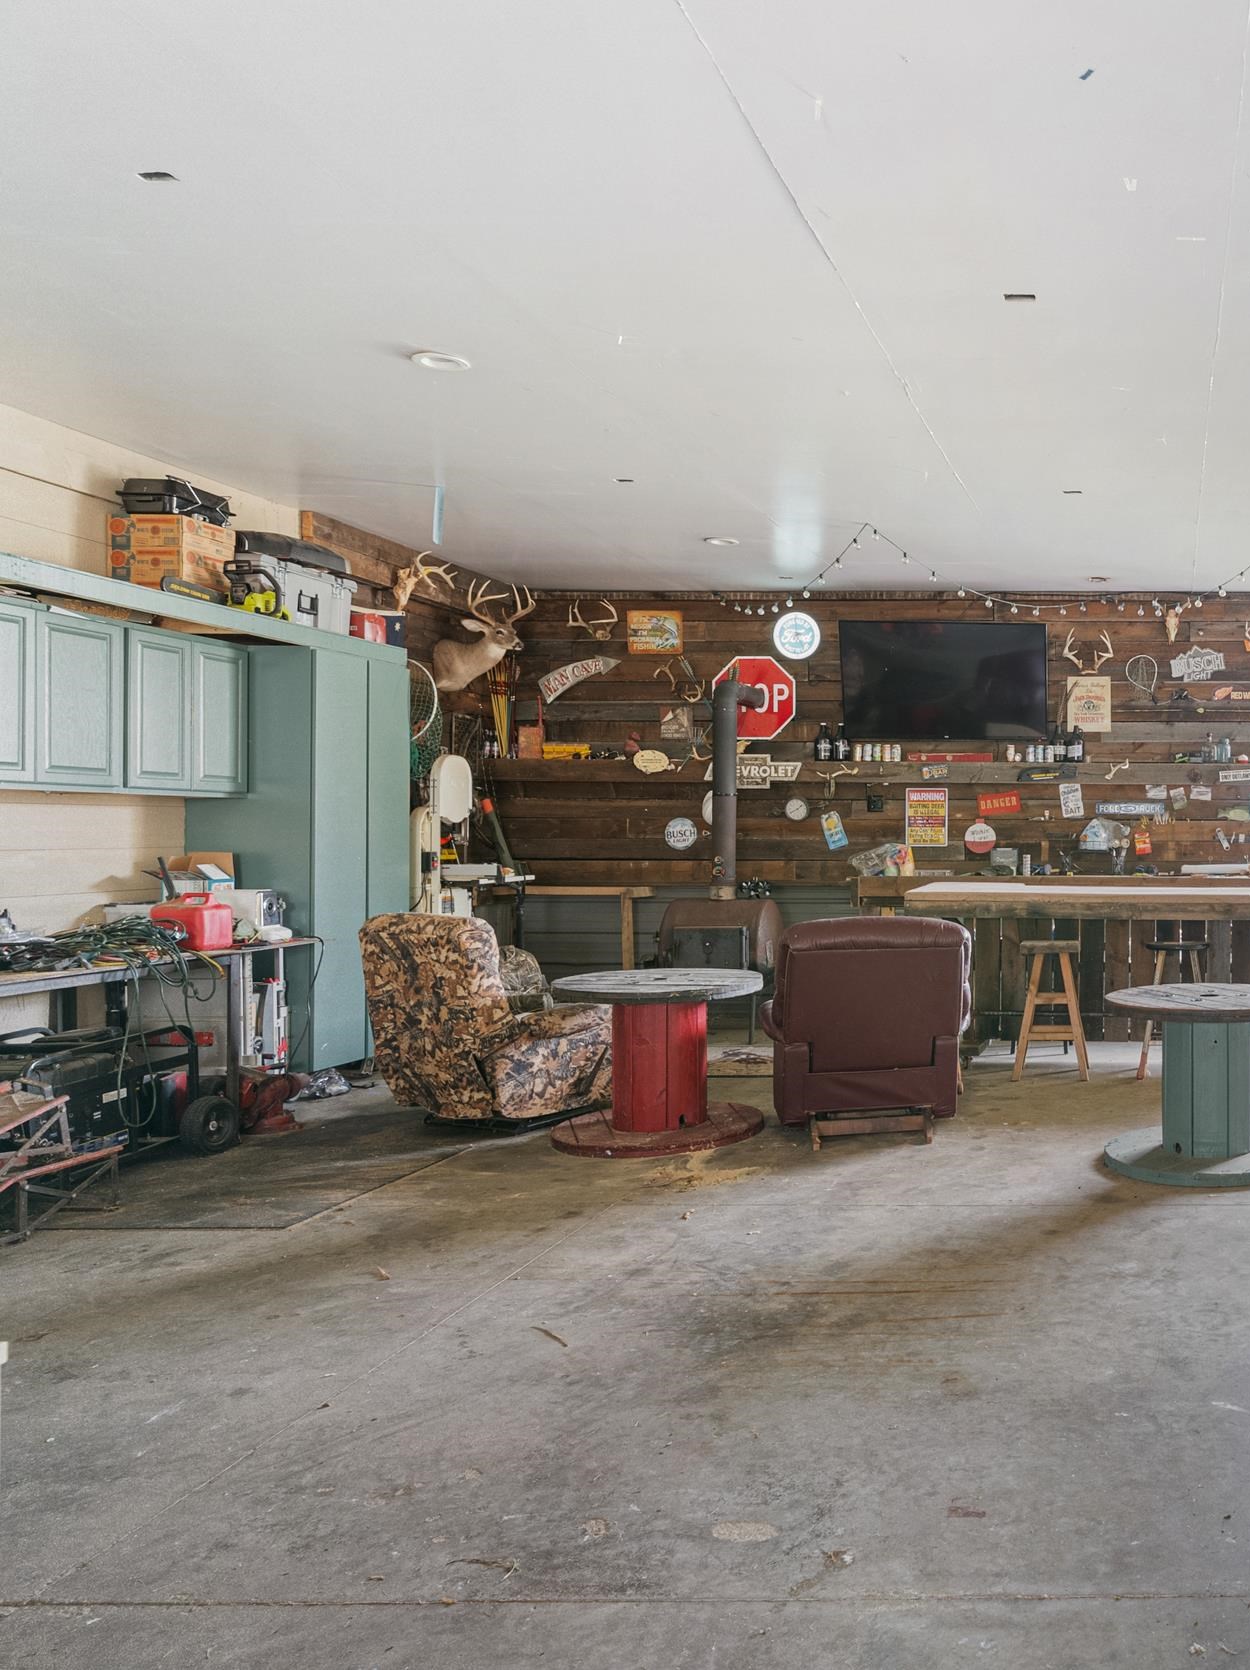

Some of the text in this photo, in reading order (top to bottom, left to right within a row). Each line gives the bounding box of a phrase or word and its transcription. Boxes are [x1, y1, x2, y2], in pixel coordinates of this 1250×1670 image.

[1170, 653, 1226, 678] BUSCH
[544, 659, 604, 697] MAN CAVE
[1184, 670, 1213, 681] LIGHT
[1231, 691, 1242, 700] RED
[736, 765, 794, 778] EVROLET
[909, 792, 945, 801] WARNING
[980, 796, 1017, 810] DANGER
[1064, 806, 1081, 815] BAIT
[666, 830, 696, 840] BUSCH
